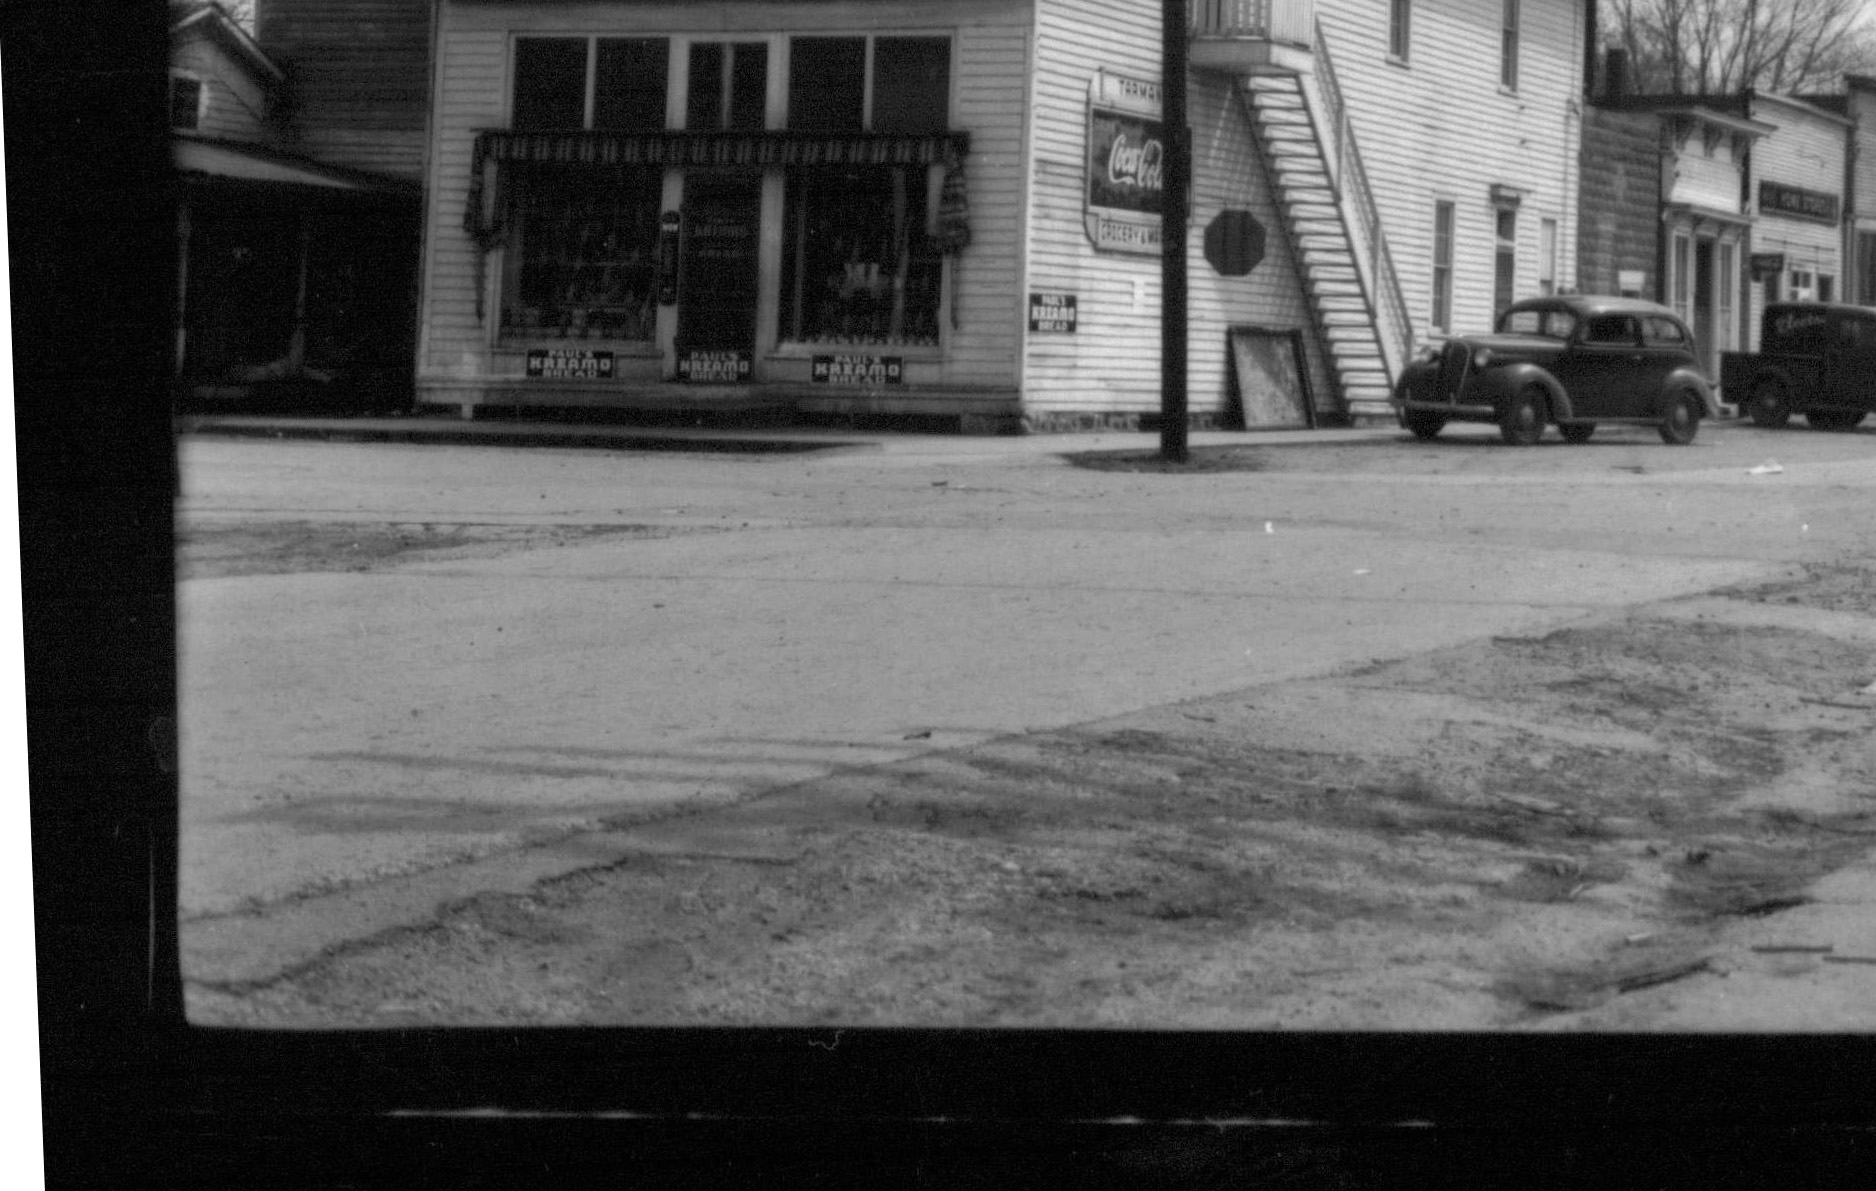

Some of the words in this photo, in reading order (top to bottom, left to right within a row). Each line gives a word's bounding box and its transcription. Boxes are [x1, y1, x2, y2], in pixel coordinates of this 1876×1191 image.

[529, 357, 612, 371] KREAMO
[679, 360, 750, 373] KREAMO
[815, 363, 901, 377] KREAMO
[541, 369, 598, 379] BREAD
[690, 371, 738, 382] BREAD
[829, 375, 887, 386] BREAD
